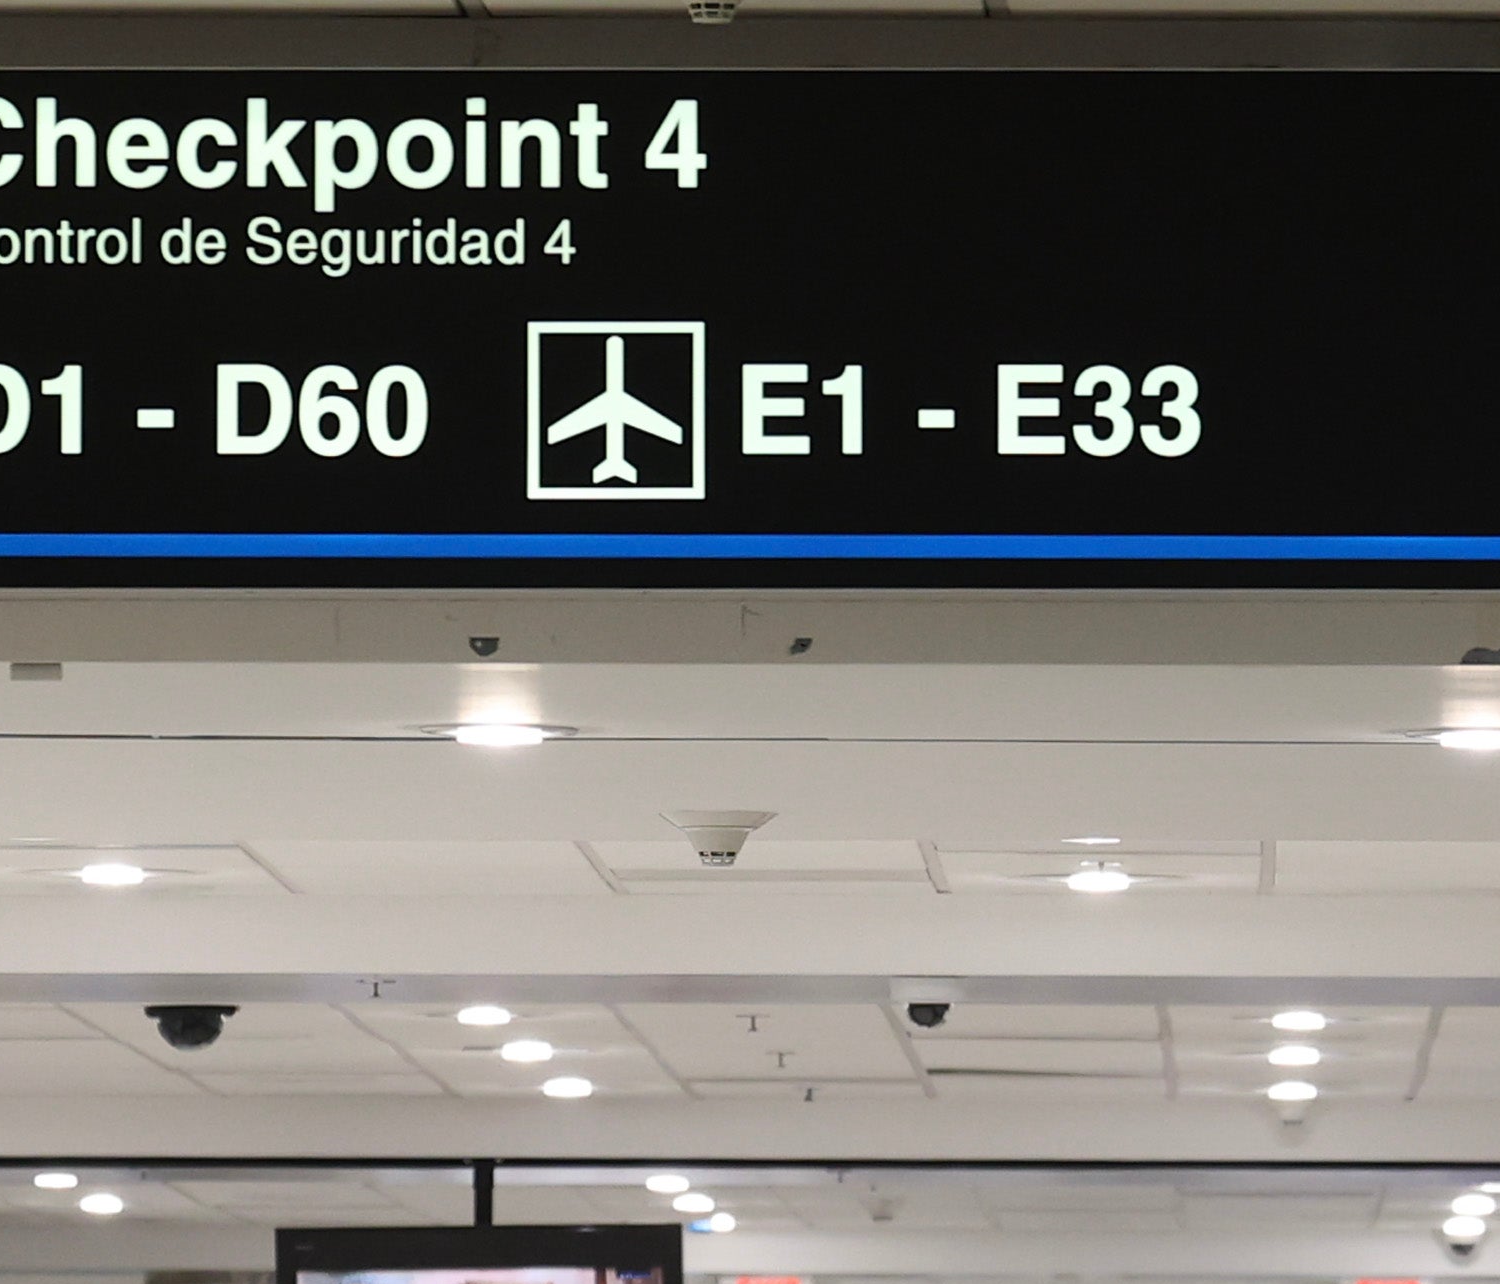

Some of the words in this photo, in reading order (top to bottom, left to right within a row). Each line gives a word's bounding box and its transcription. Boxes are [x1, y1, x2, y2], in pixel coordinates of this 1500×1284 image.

[645, 98, 707, 188] 4
[160, 216, 226, 265] de
[246, 216, 525, 277] Seguridad
[544, 218, 577, 265] 4
[217, 363, 429, 458] D60
[742, 363, 863, 456] E1
[997, 363, 1202, 458] E33
